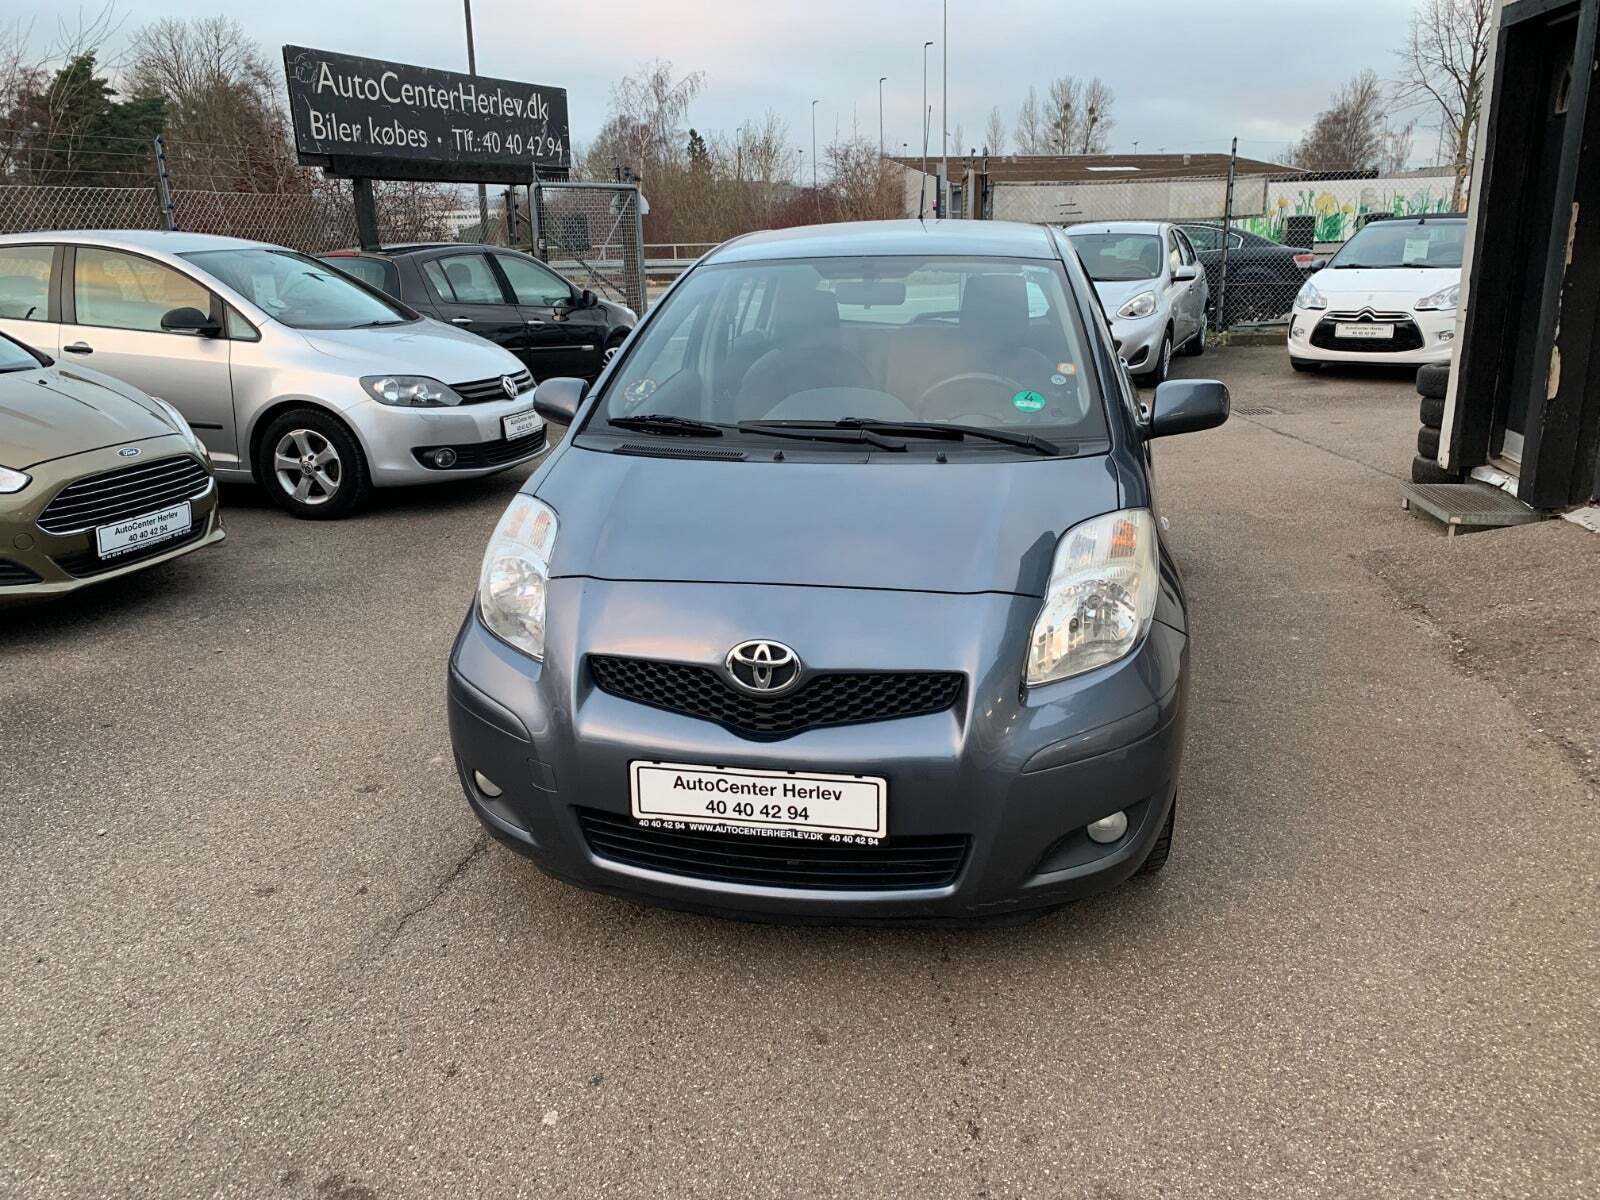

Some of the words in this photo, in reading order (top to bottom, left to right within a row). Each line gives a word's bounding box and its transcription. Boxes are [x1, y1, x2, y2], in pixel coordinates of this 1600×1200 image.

[317, 61, 549, 120] AutoCenterHerlev.dk
[309, 109, 362, 143] Biler
[368, 115, 429, 148] købes
[505, 132, 522, 155] 40
[526, 135, 544, 156] 42
[546, 136, 563, 161] 94
[114, 516, 156, 536] AutoCenter
[157, 510, 178, 524] Herlev
[128, 533, 138, 543] 40
[139, 530, 149, 540] 40
[149, 527, 159, 537] 42
[160, 524, 169, 533] 94
[673, 775, 778, 797] AutoCenter
[783, 783, 842, 801] Herlev
[705, 800, 727, 815] 40
[732, 802, 754, 817] 40
[760, 804, 782, 819] 42
[787, 805, 810, 821] 94
[638, 819, 650, 828] 40
[651, 820, 661, 829] 40
[663, 821, 674, 829] 42
[675, 821, 686, 830] 94
[689, 822, 824, 841] WWW.AUTOCENTERHERLEV.DK
[829, 834, 841, 843] 40
[842, 835, 853, 844] 40
[855, 836, 866, 845] 42
[867, 837, 879, 846] 94
